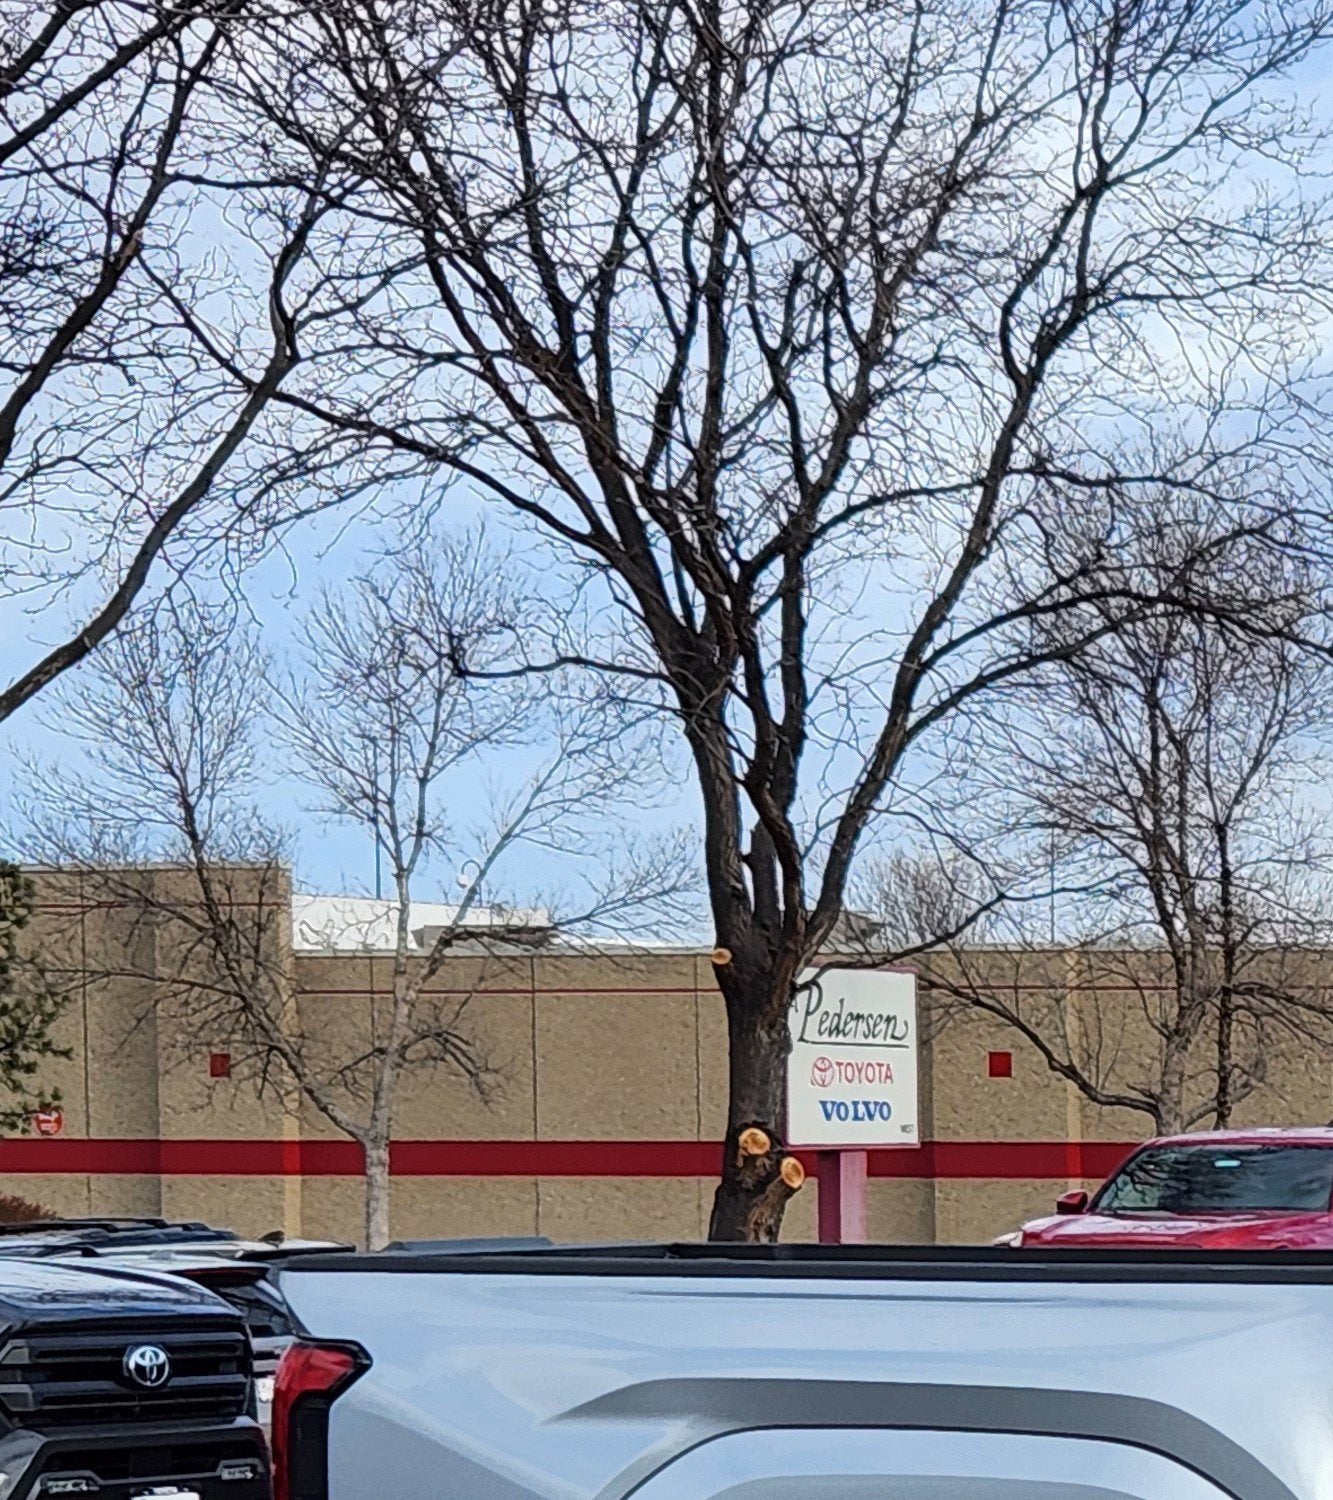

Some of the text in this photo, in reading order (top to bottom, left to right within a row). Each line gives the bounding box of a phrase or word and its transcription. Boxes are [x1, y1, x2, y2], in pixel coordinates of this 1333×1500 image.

[797, 980, 909, 1044] Pedersen
[835, 1061, 894, 1085] TOYOTA
[819, 1100, 892, 1122] VOLVO
